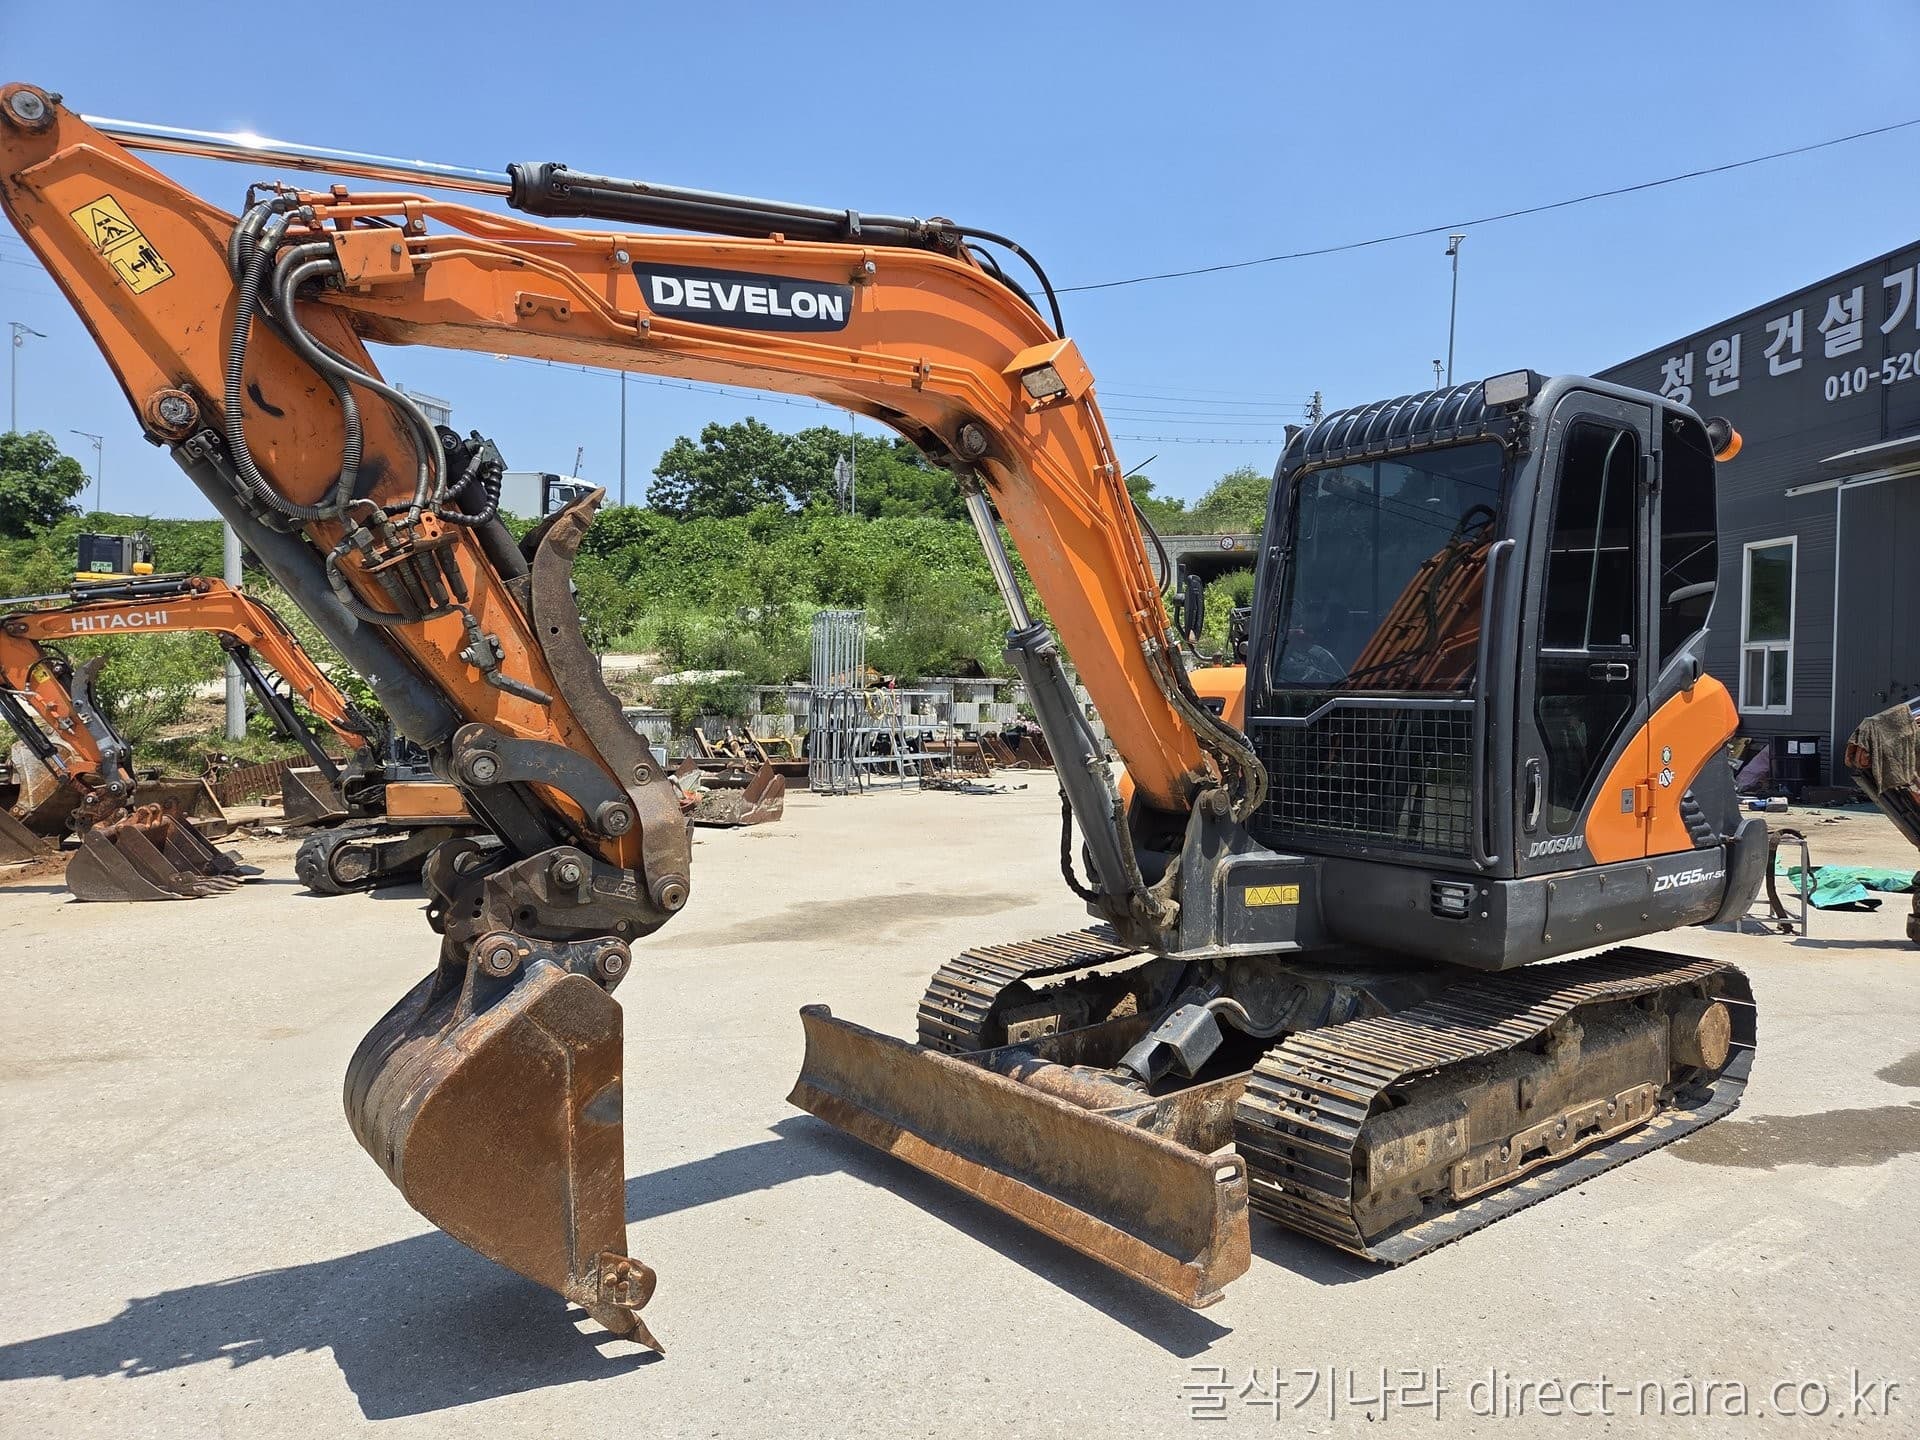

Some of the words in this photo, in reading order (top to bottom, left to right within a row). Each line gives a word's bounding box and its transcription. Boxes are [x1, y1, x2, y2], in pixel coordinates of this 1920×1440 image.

[651, 275, 844, 322] DEVELON
[1659, 333, 1742, 406] 청원
[71, 610, 168, 632] HITACHI
[1529, 835, 1584, 858] DOOSAN
